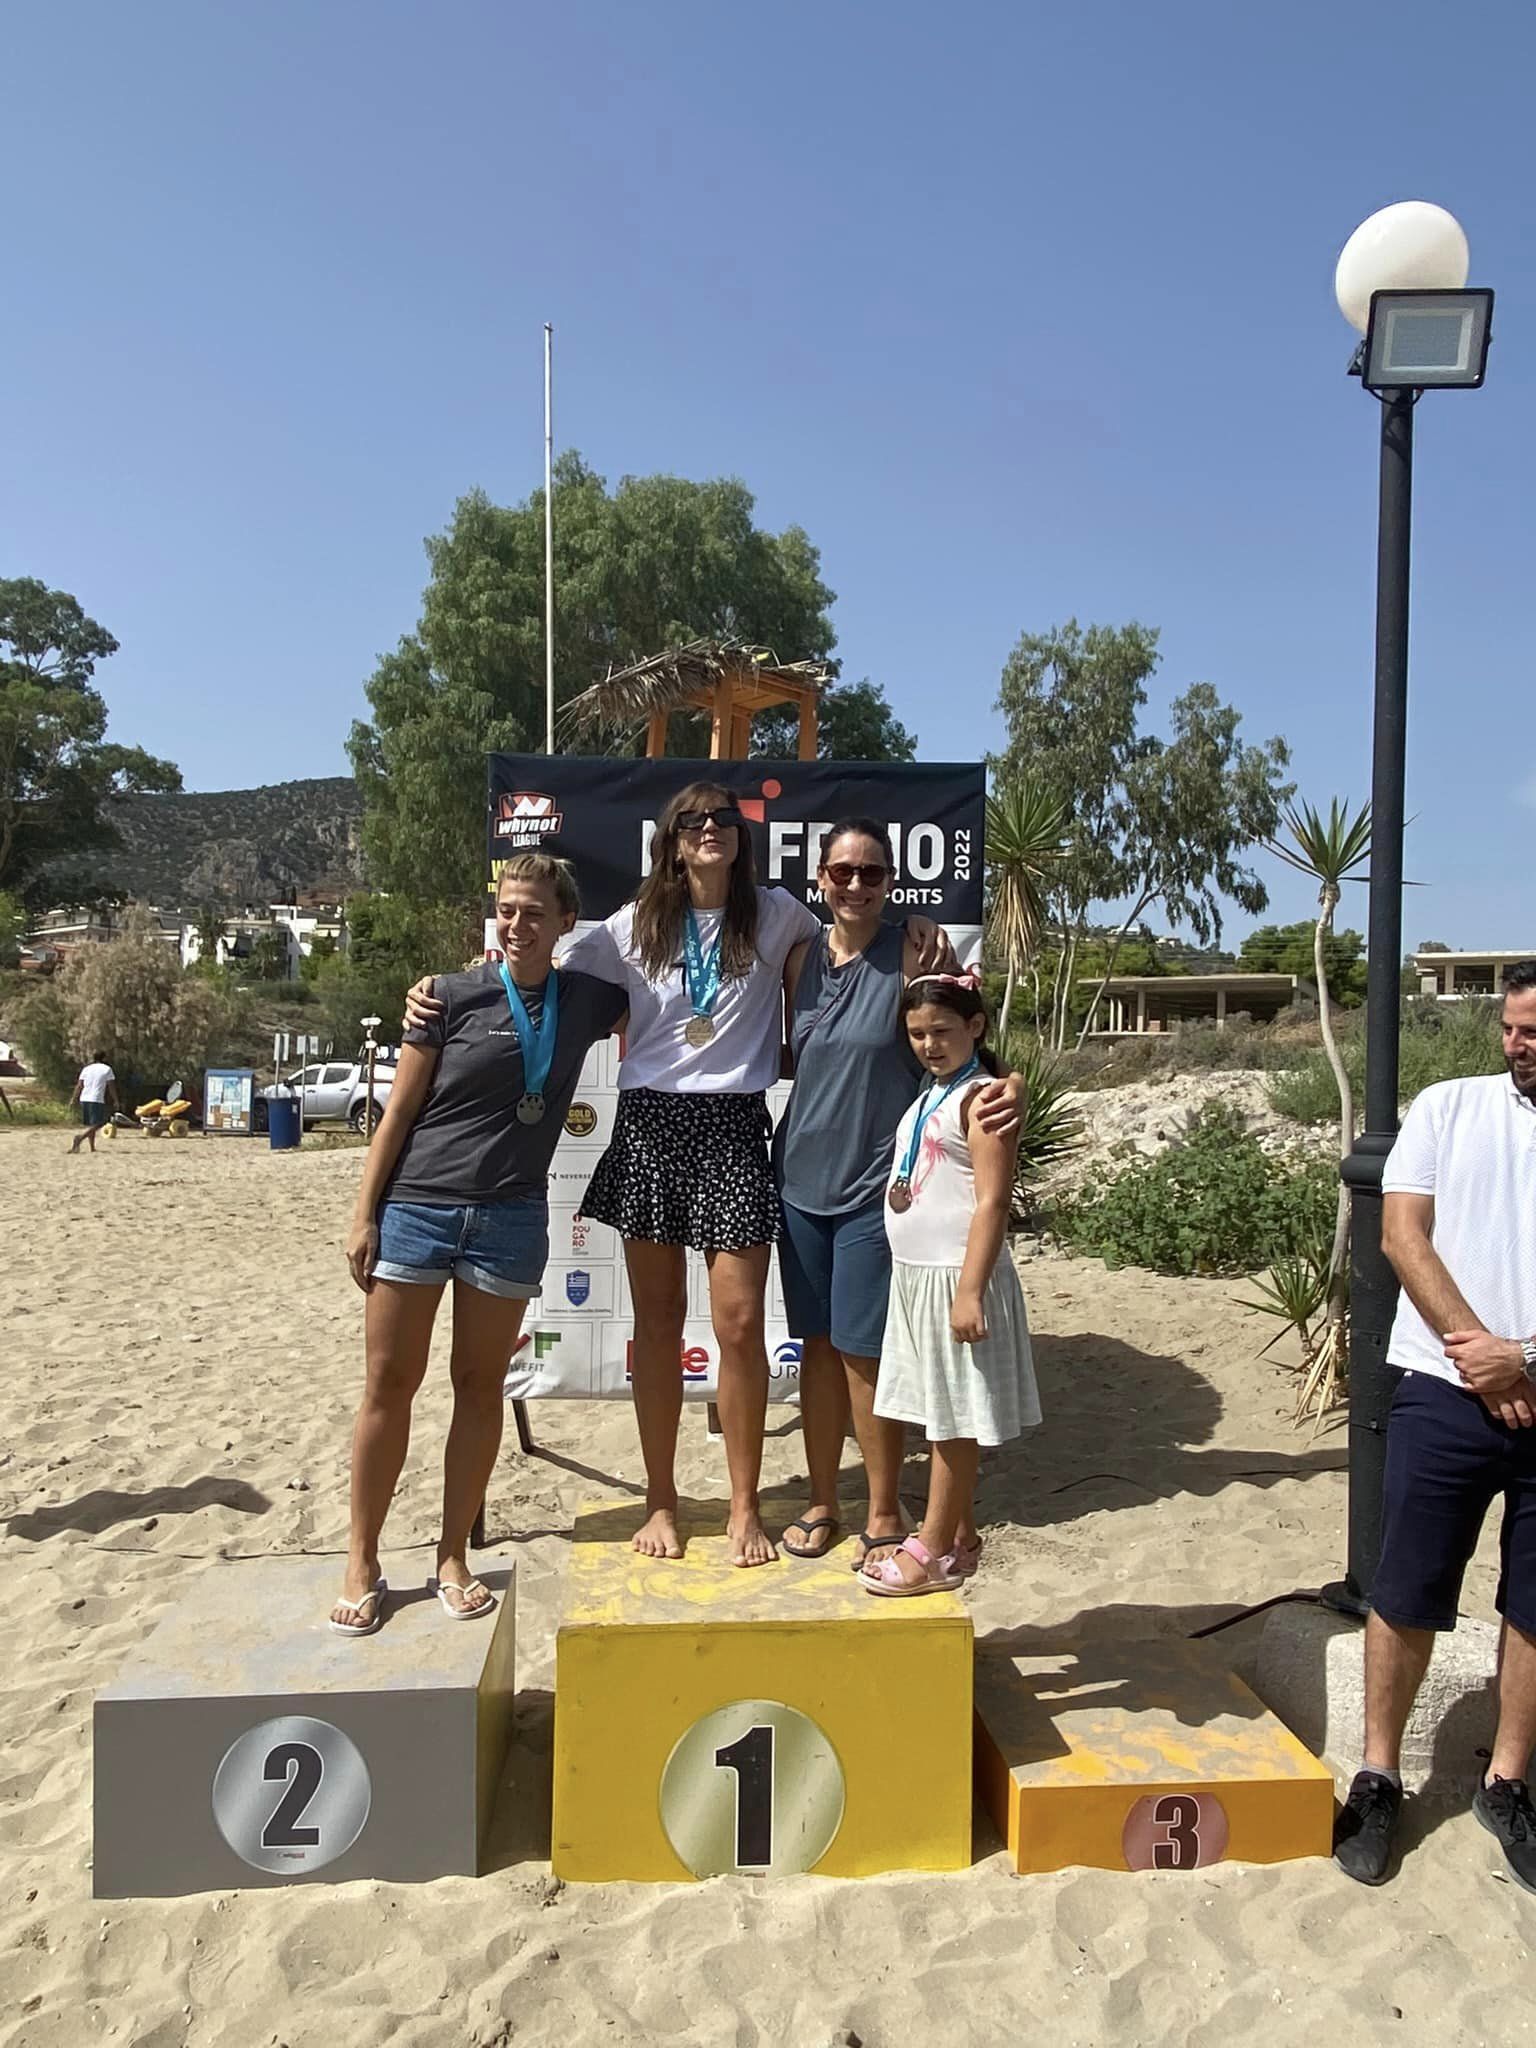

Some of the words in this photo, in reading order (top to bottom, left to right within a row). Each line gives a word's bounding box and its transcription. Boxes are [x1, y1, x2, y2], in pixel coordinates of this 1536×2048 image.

[498, 816, 559, 834] whynot
[512, 833, 542, 848] LEAGUE
[954, 829, 971, 881] 2022
[261, 1741, 324, 1848] 2
[714, 1725, 775, 1868] 1
[1152, 1794, 1200, 1870] 3
